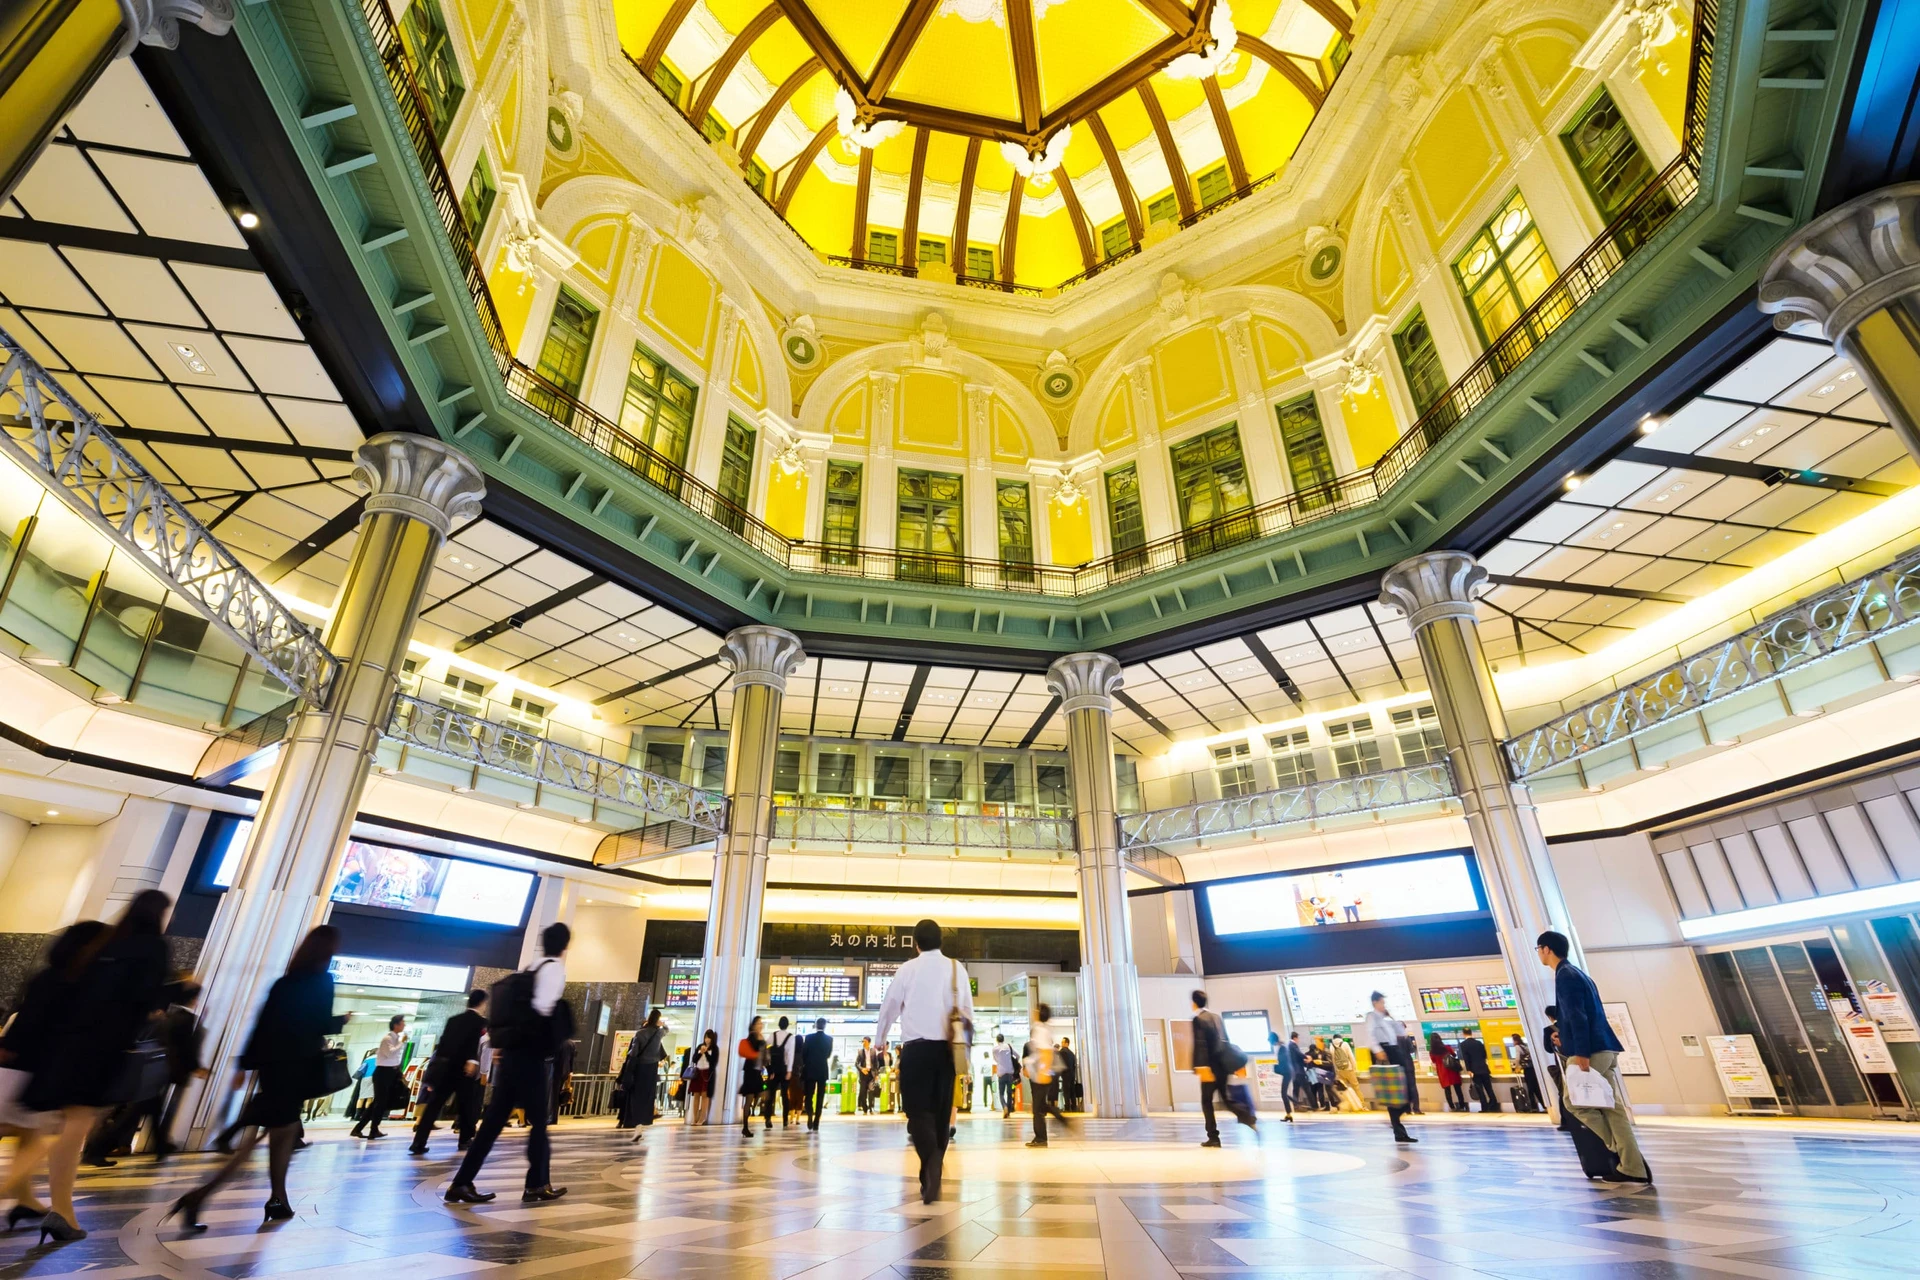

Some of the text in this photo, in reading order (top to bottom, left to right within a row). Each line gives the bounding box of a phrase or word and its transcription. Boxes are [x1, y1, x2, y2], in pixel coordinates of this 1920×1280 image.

[830, 933, 914, 948] 丸の内北口
